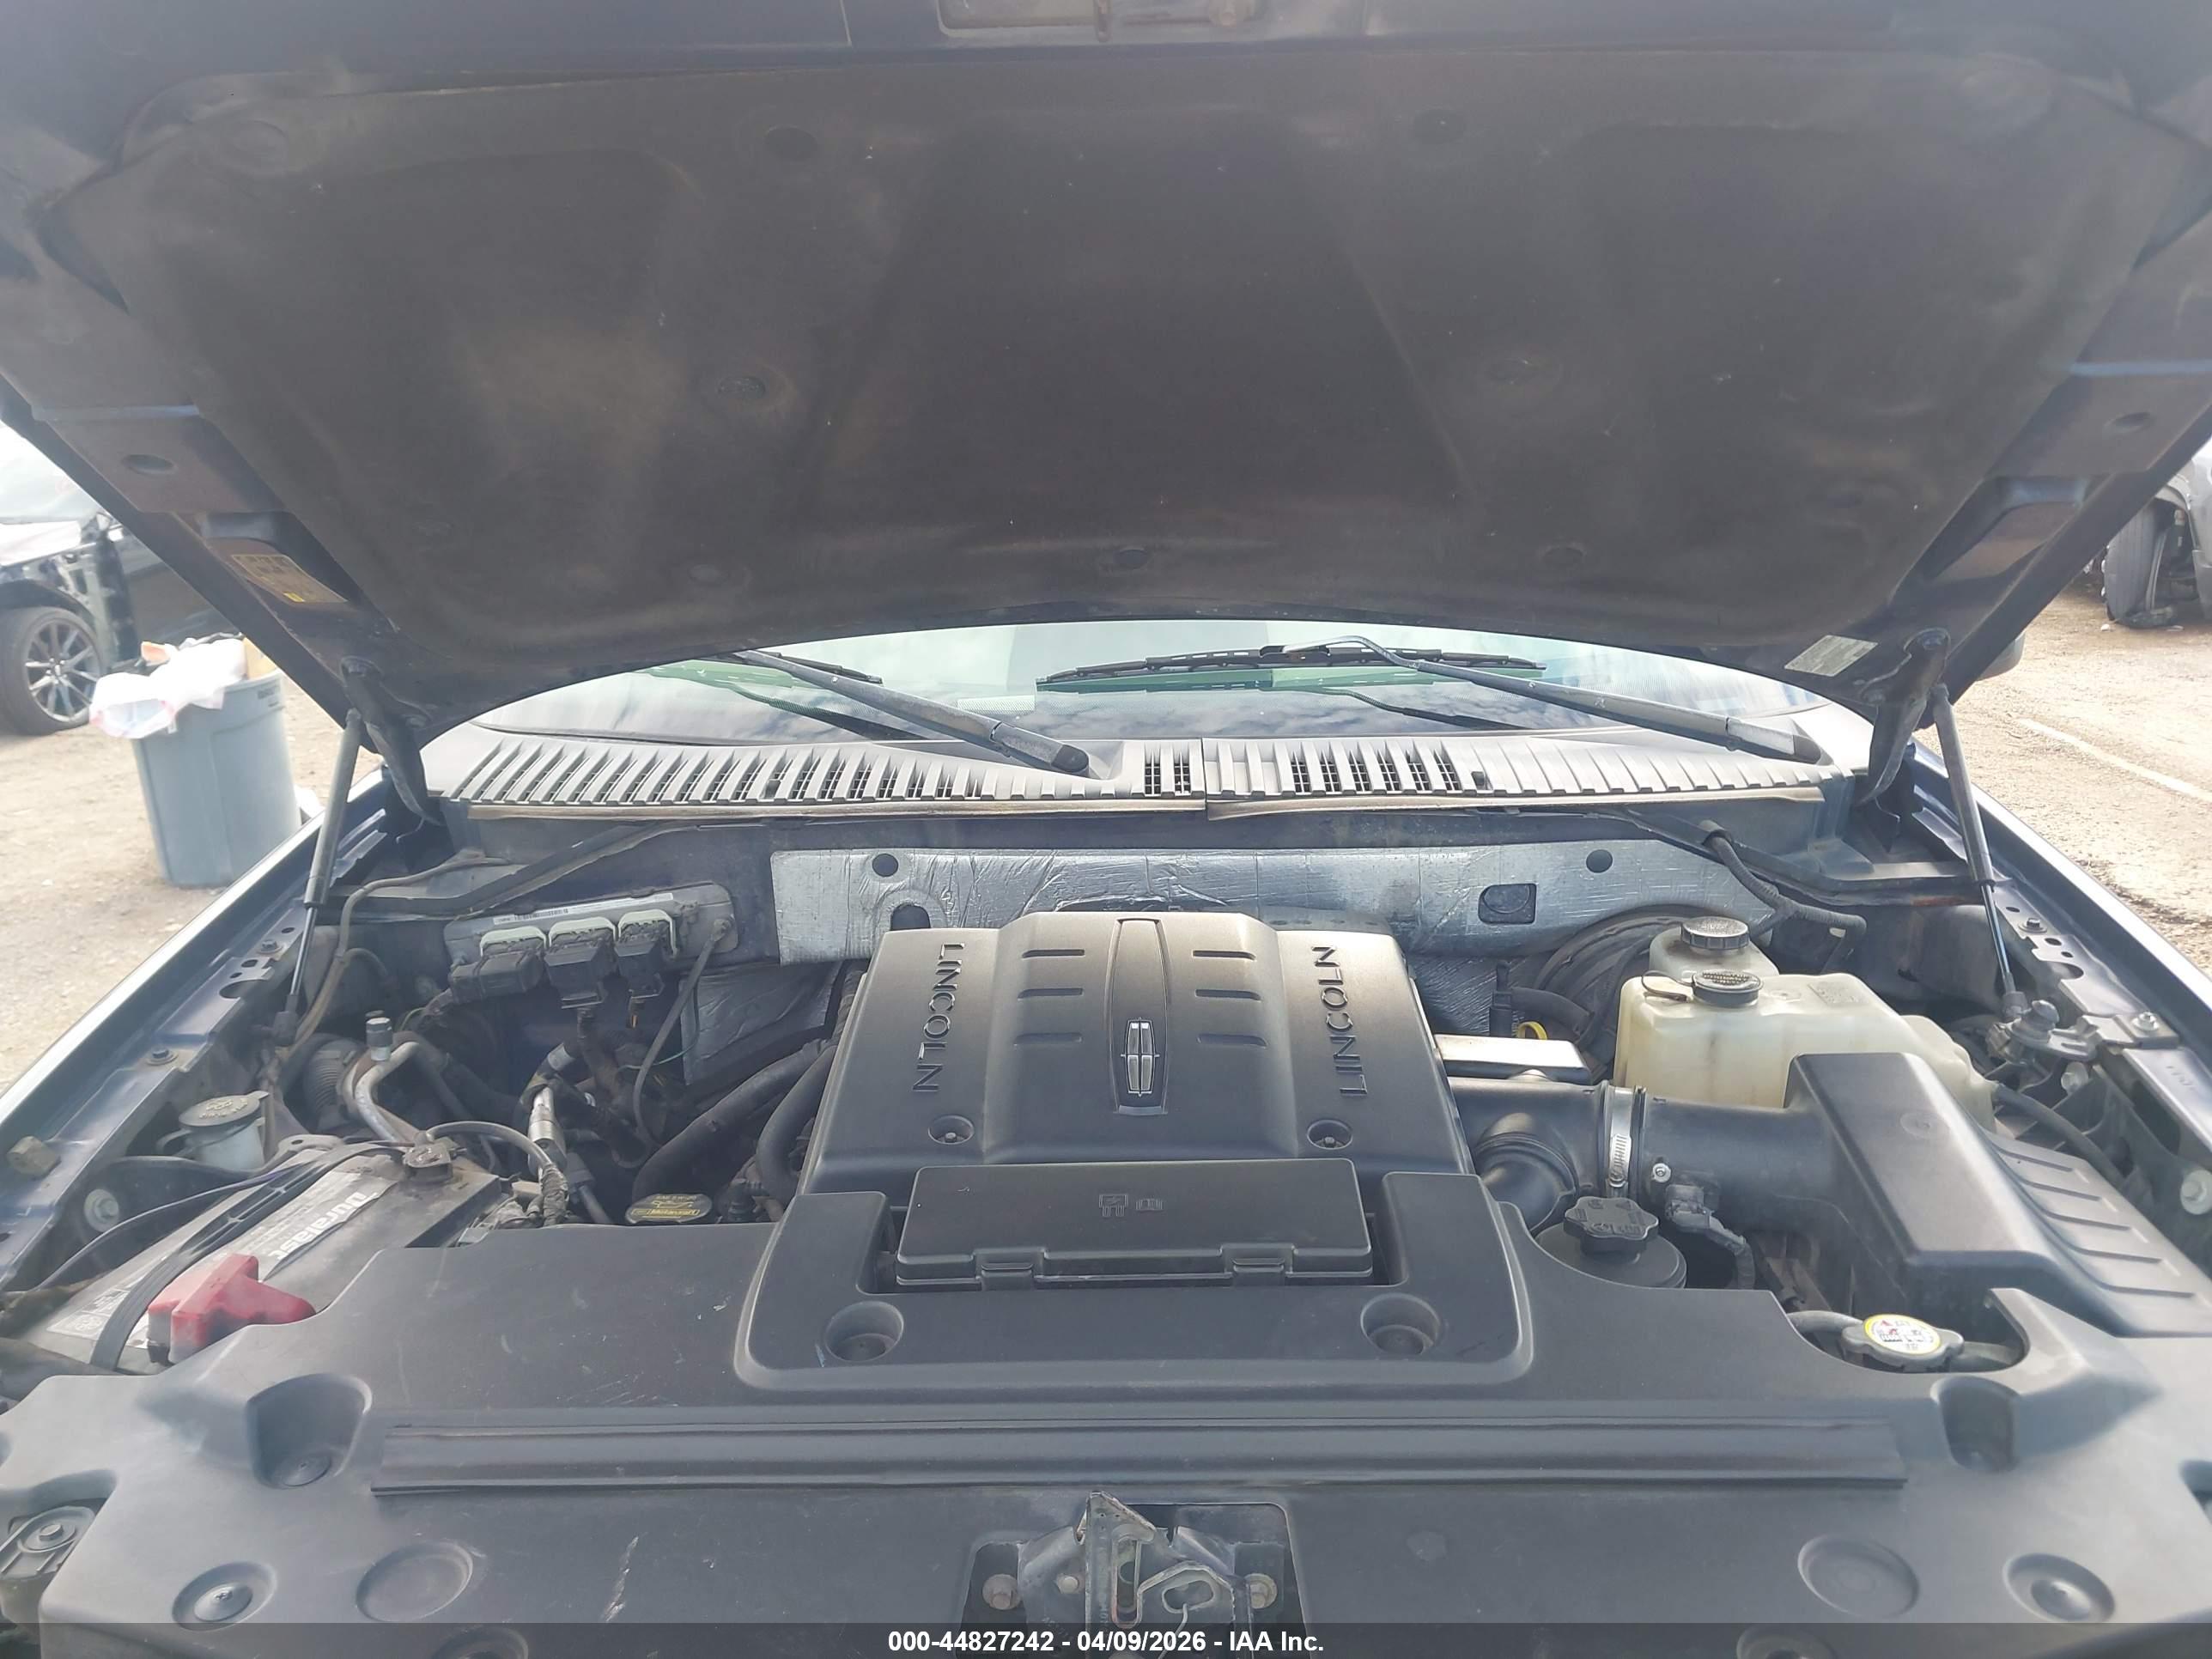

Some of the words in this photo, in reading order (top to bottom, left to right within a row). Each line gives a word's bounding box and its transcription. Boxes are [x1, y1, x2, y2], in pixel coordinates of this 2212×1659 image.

[911, 942, 965, 1092] LINCOLN
[1310, 945, 1369, 1097] LINCOLN
[267, 1191, 379, 1261] Duralast
